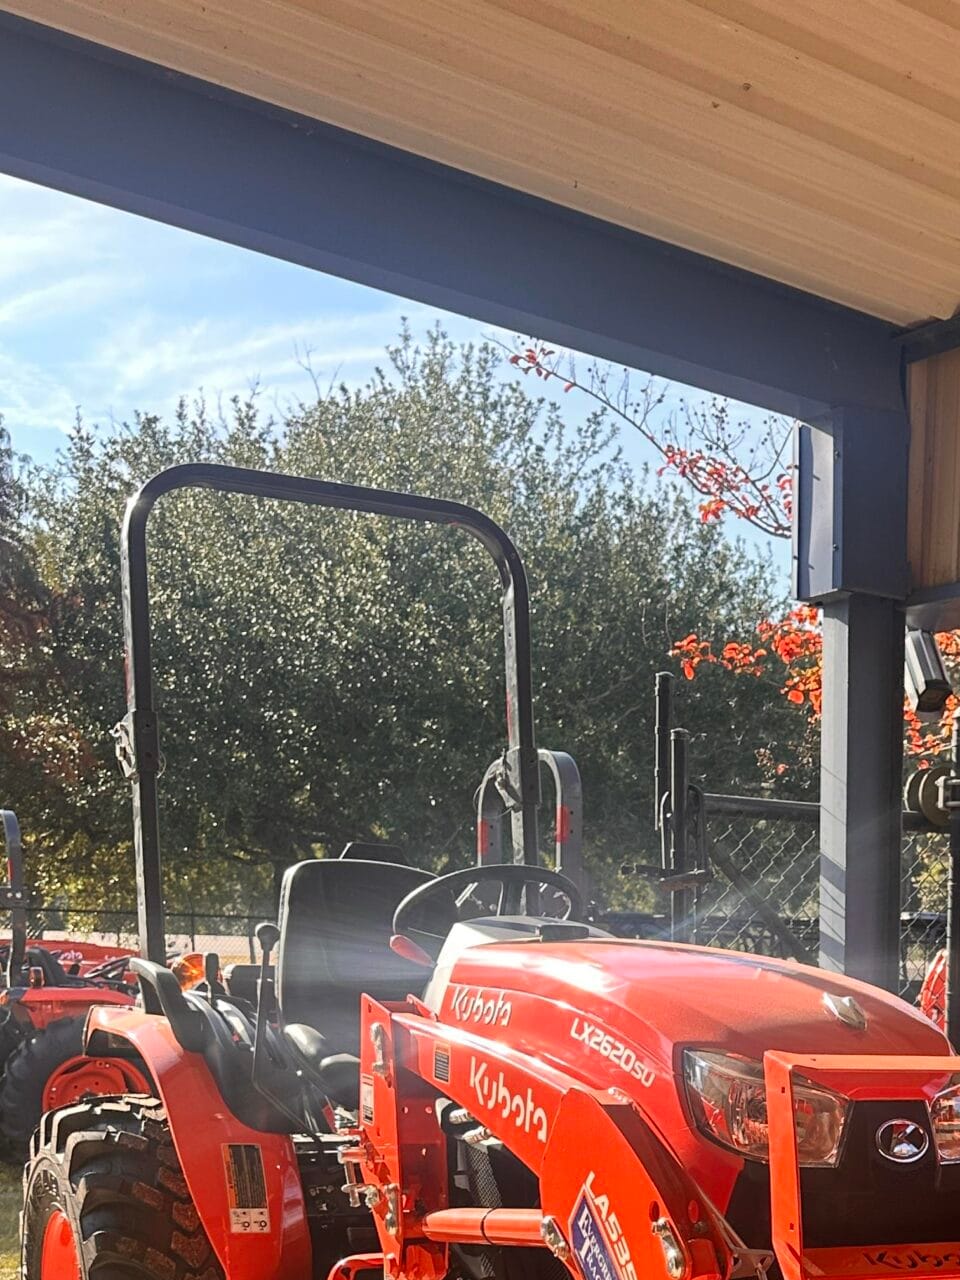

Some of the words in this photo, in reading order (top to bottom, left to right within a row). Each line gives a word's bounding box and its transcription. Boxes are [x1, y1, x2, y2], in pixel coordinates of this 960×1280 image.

[451, 985, 513, 1027] Kubota
[570, 1017, 656, 1088] LX2620SU
[470, 1056, 548, 1143] Kubota
